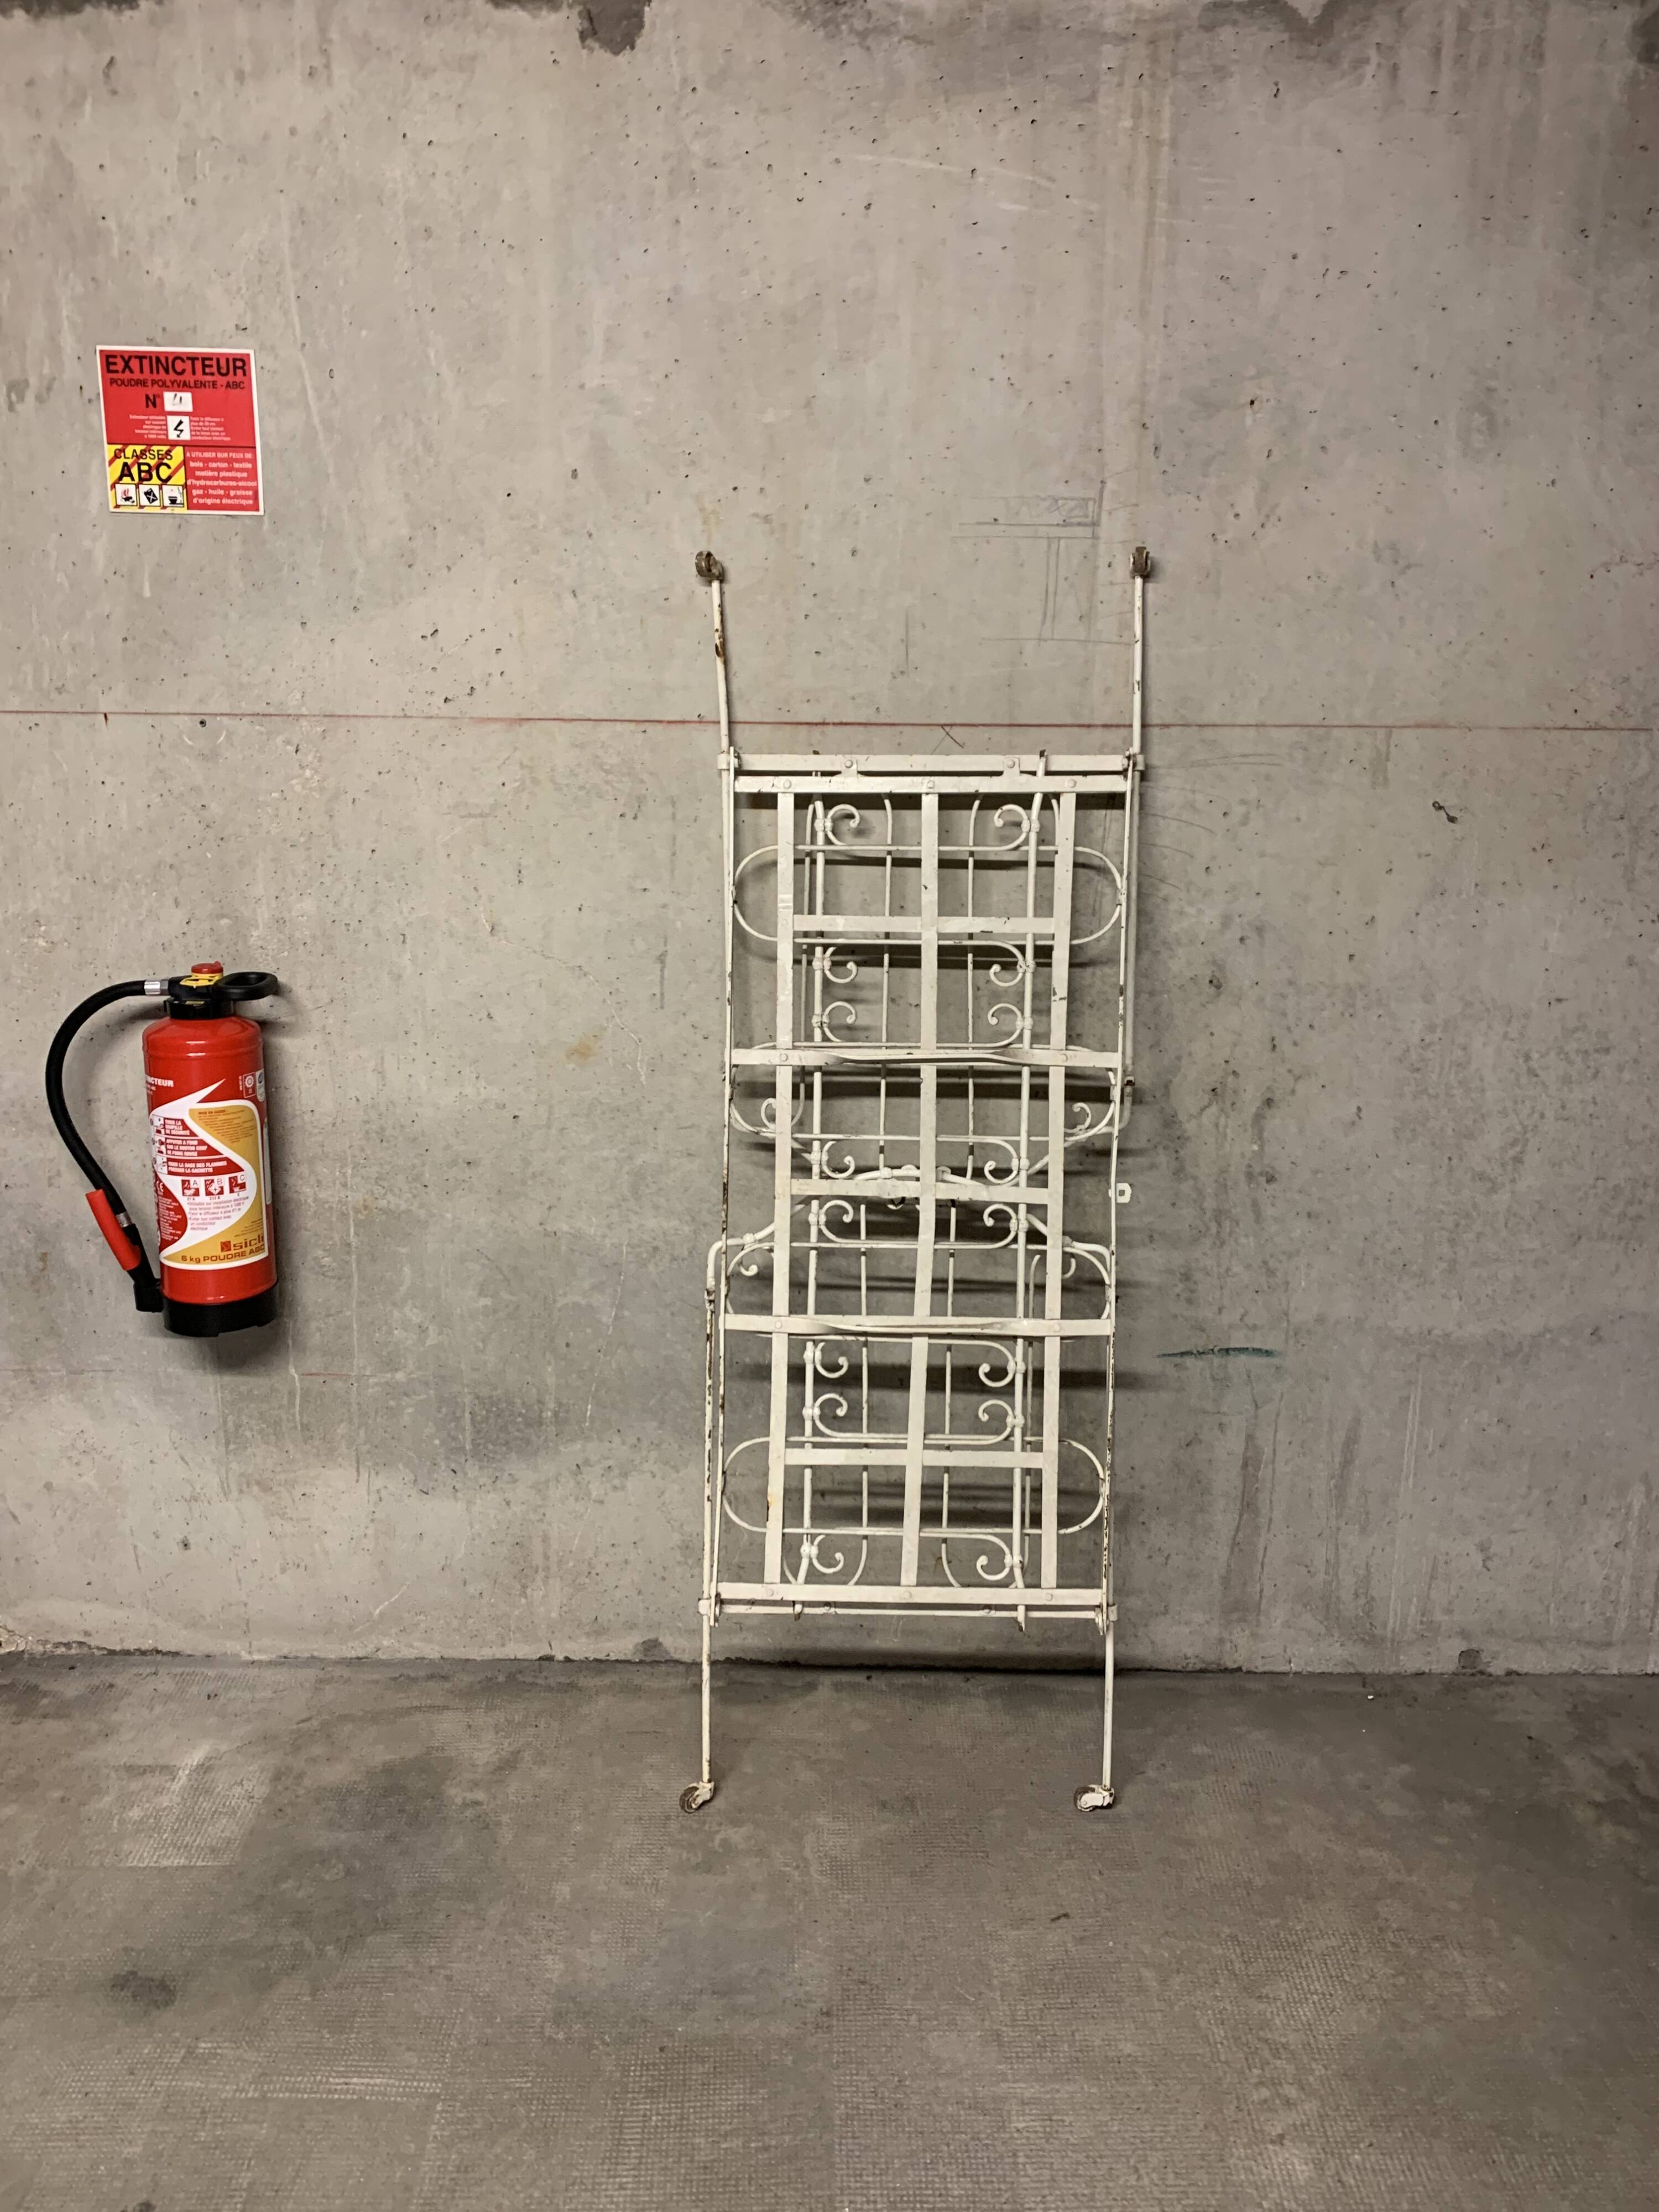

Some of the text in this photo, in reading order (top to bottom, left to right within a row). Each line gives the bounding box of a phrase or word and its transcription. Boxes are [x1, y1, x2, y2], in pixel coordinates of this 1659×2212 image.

[105, 354, 247, 377] EXTINCTEUR
[109, 378, 149, 387] POUDRE
[151, 379, 218, 389] POLYVALENTE
[225, 380, 245, 389] ABC
[114, 448, 173, 460] CLASSES
[119, 462, 173, 483] ABC
[233, 1233, 264, 1250] sicli
[204, 1250, 247, 1262] POUDRE
[249, 1245, 265, 1255] ABC
